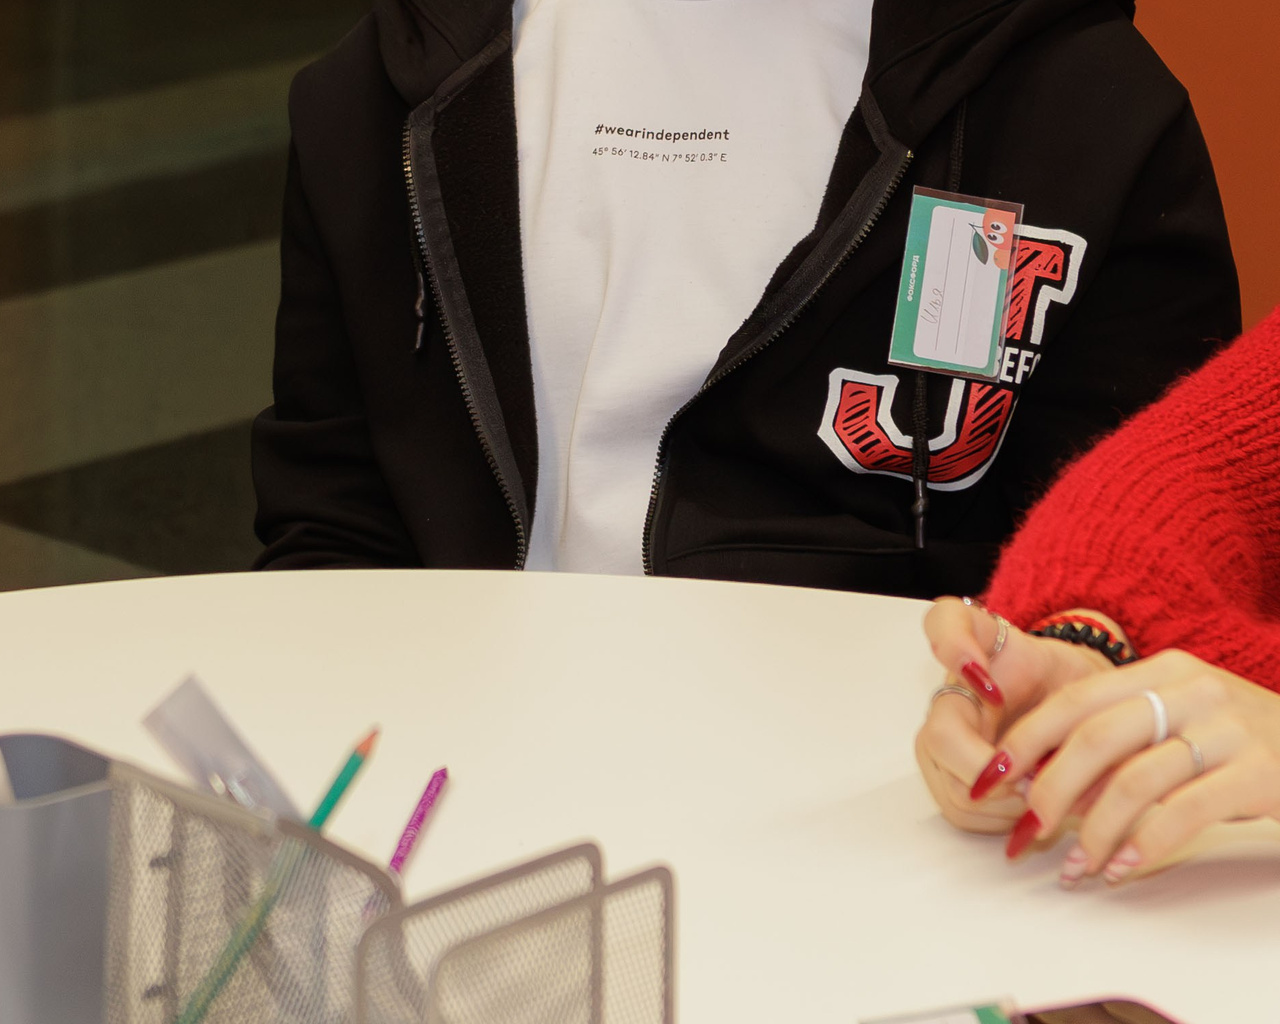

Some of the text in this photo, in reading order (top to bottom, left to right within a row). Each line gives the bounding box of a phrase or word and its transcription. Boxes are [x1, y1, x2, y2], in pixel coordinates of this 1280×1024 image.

[594, 123, 730, 143] #wearindependent
[662, 154, 670, 162] N
[720, 153, 728, 163] E
[906, 255, 920, 302] ФОКСФОРД
